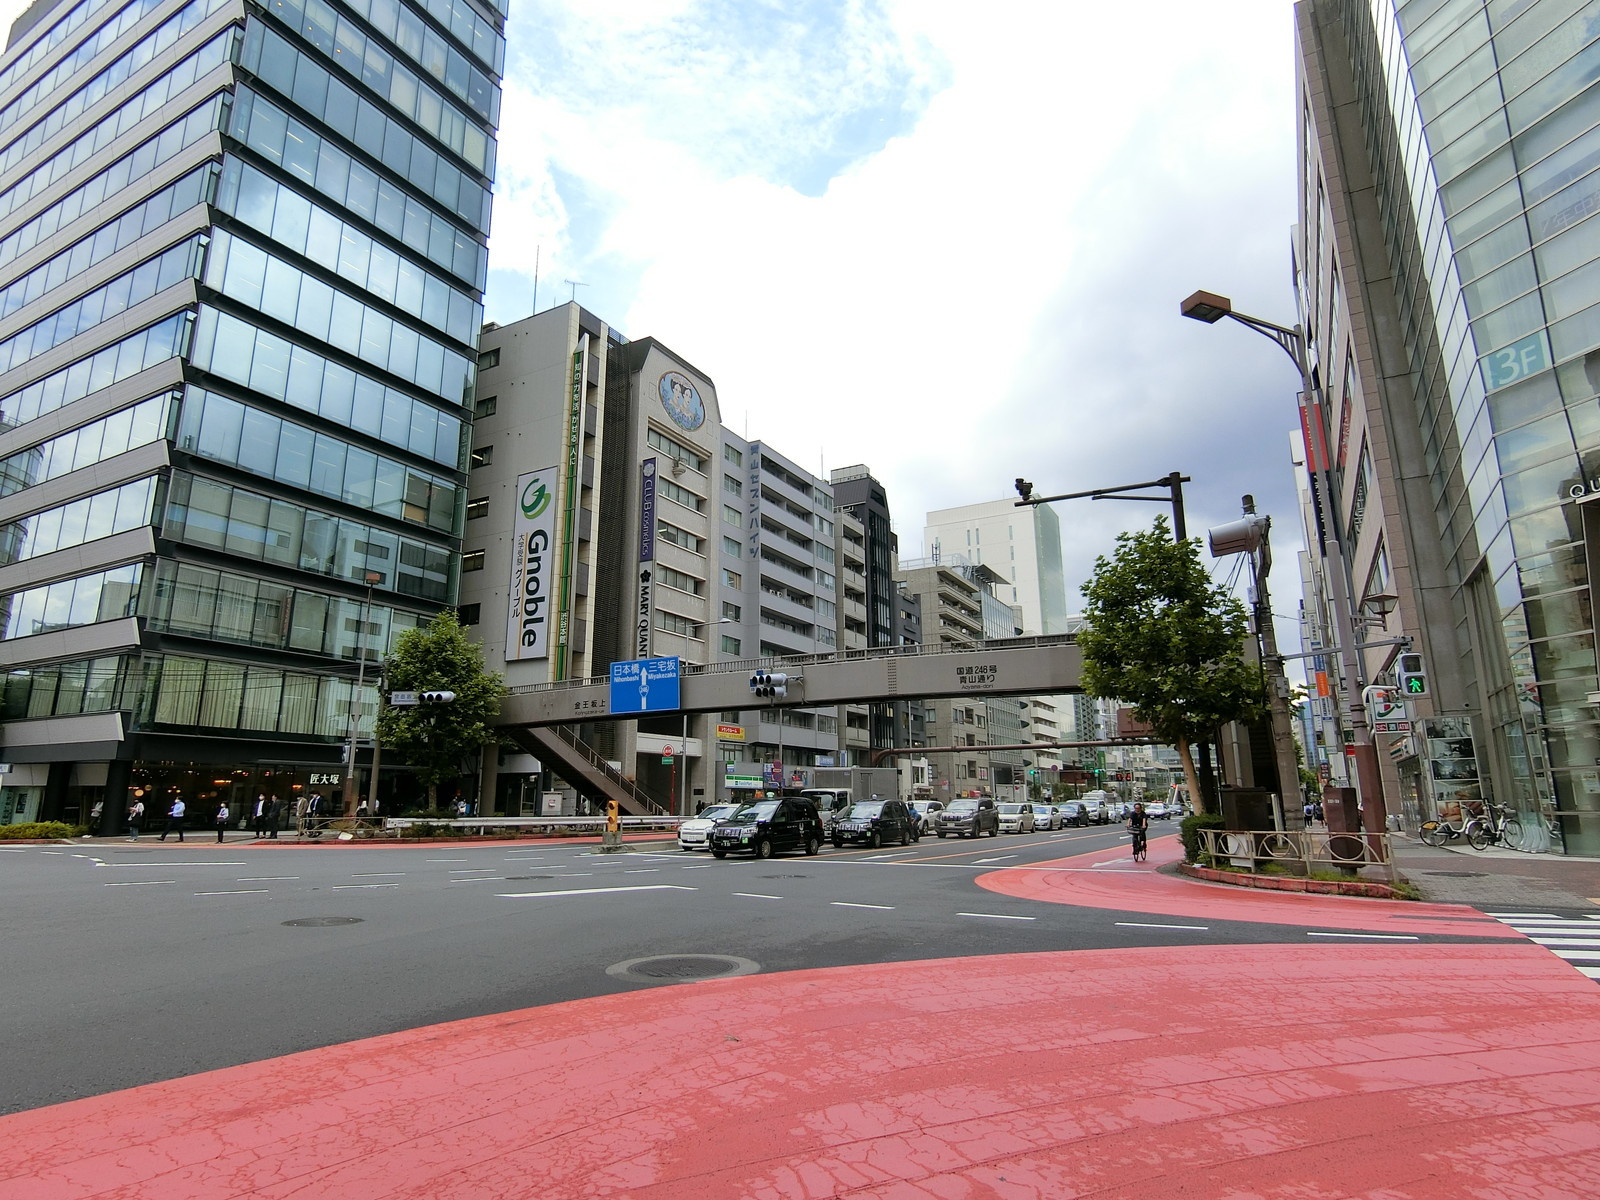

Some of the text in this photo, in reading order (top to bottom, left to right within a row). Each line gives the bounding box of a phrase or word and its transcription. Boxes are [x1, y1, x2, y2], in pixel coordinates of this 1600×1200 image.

[1495, 345, 1537, 385] 3F
[522, 529, 549, 648] Gnoble
[638, 585, 650, 659] MARY QUANT
[614, 660, 676, 676] 日本橋 三宅坂
[956, 664, 997, 675] 国道246号
[614, 675, 640, 683] Nihonbashi
[959, 674, 995, 684] 青山通り
[575, 699, 606, 710] 金王坂上
[310, 773, 340, 785] 匠大塚
